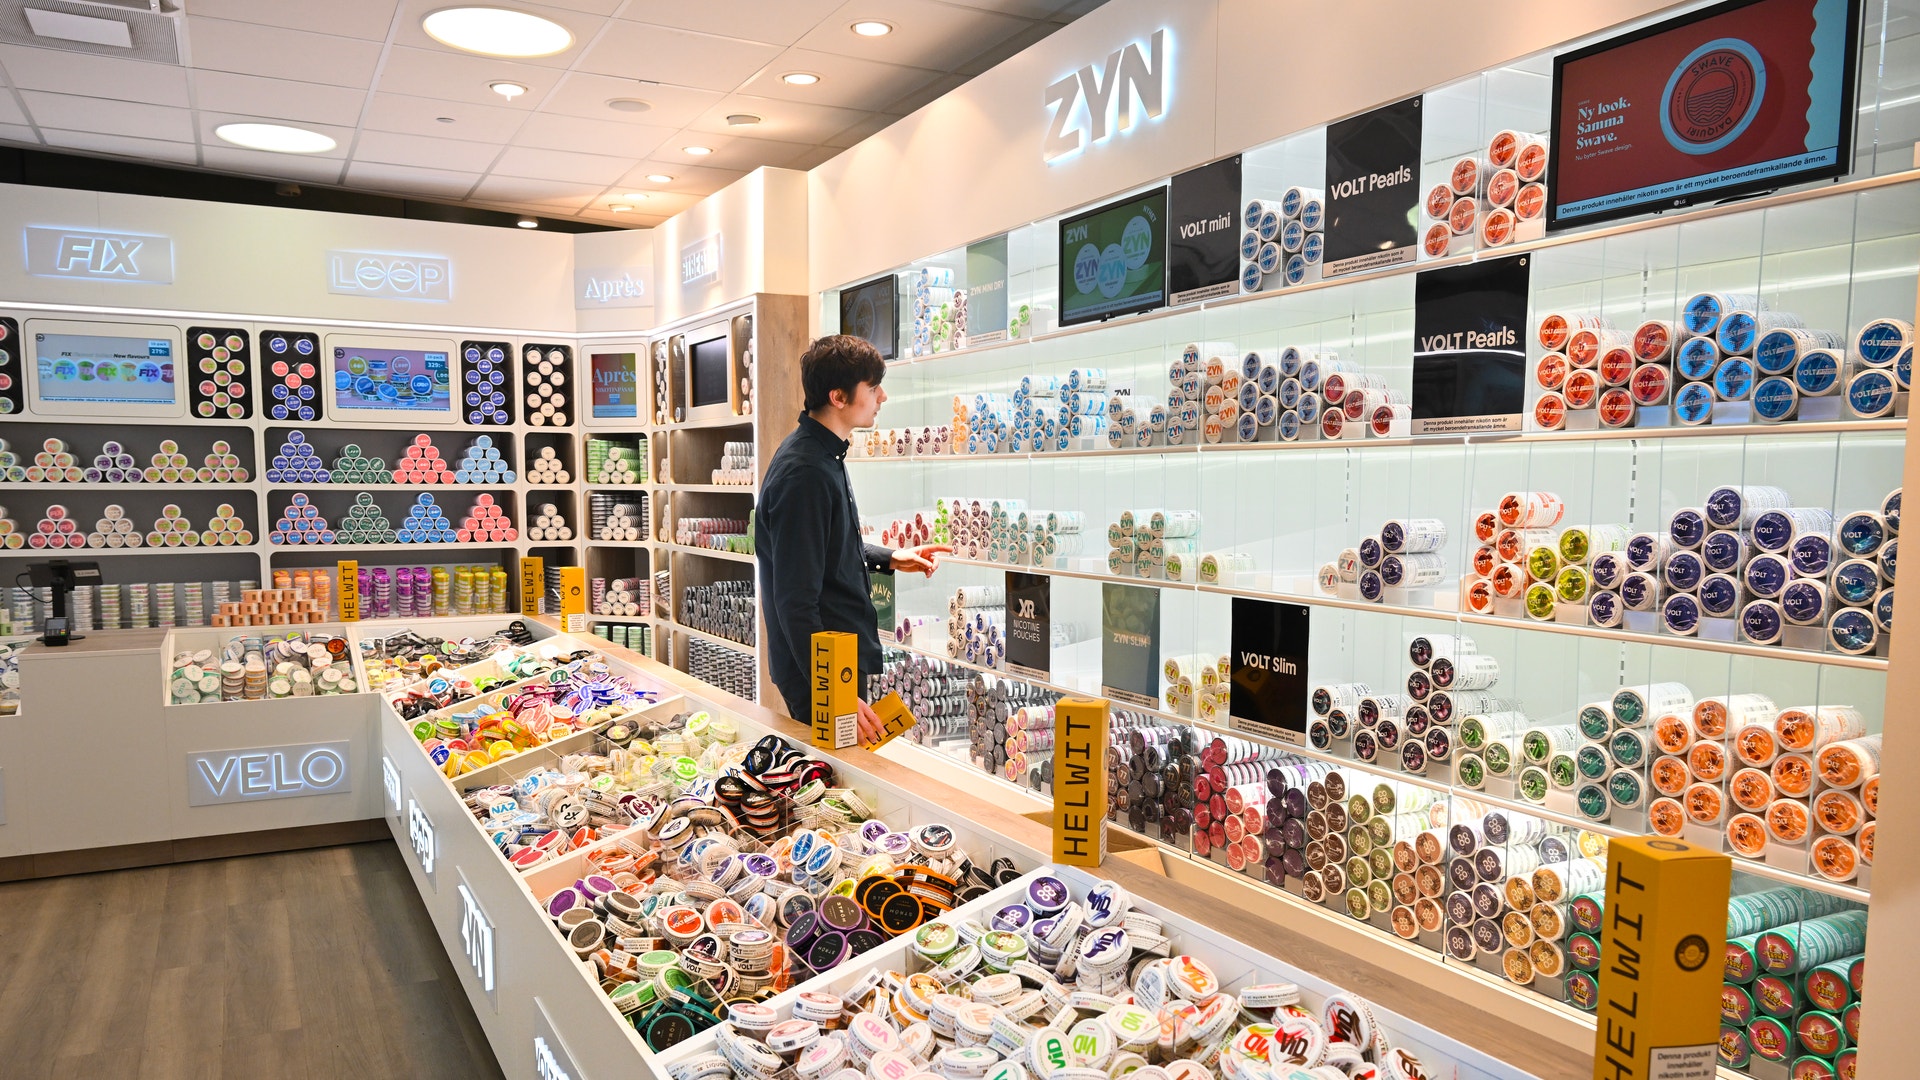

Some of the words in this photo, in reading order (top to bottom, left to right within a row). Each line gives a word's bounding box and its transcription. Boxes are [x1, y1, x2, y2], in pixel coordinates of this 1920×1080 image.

[1691, 56, 1735, 77] SWAVE
[1044, 28, 1165, 165] ZYN
[1578, 106, 1595, 121] Ny
[1597, 96, 1631, 117] look.
[1576, 113, 1624, 135] Samma
[1687, 117, 1733, 138] DAIQUIRI
[1576, 130, 1618, 150] Swave.
[1597, 147, 1613, 156] Swave
[1331, 174, 1367, 200] VOLT
[1562, 205, 1581, 215] Denna
[1581, 200, 1605, 213] produkt
[1605, 192, 1636, 208] innehåller
[1636, 190, 1659, 199] nikotin
[1660, 187, 1675, 195] som
[1675, 183, 1683, 192] är
[1684, 181, 1693, 190] ett
[1694, 176, 1720, 188] mycket
[1720, 159, 1803, 182] beroendeframkallande
[1803, 152, 1829, 166] ämne.
[1180, 218, 1207, 239] VOLT
[1208, 212, 1231, 231] mini
[1066, 224, 1088, 244] ZYN
[1123, 231, 1150, 252] ZYN
[57, 235, 143, 275] FIX
[333, 256, 444, 293] LOOP
[584, 272, 644, 302] Après
[1421, 332, 1463, 352] VOLT
[1184, 352, 1199, 362] ZYN
[1758, 349, 1777, 358] VOLT
[54, 366, 75, 376] FIX
[139, 368, 159, 378] FIX
[1170, 368, 1185, 378] ZYN
[1206, 365, 1223, 375] ZYN
[592, 366, 636, 386] Après
[1223, 377, 1239, 389] ZYN
[1206, 394, 1222, 404] ZYN
[1851, 390, 1872, 399] VOLT
[1109, 403, 1122, 413] ZYN
[1151, 413, 1164, 423] ZYN
[1168, 425, 1183, 436] ZYN
[1205, 424, 1221, 433] ZYN
[1109, 430, 1122, 440] ZYN
[1121, 519, 1133, 528] ZYN
[1674, 523, 1689, 531] VOLT
[1167, 561, 1181, 572] ZYN
[1202, 563, 1217, 573] ZYN
[1594, 567, 1608, 575] VOLT
[1751, 570, 1767, 578] VOLT
[1320, 575, 1339, 585] ZYN
[1839, 578, 1858, 586] VOLT
[344, 564, 355, 619] HELWIT
[524, 561, 534, 612] HELWIT
[1624, 586, 1637, 594] VOLT
[1702, 591, 1718, 599] VOLT
[1018, 598, 1036, 619] XR
[1013, 619, 1040, 633] NICOTINE
[1834, 626, 1854, 635] VOLT
[1013, 630, 1041, 643] POUCHES
[1113, 632, 1129, 645] ZYN
[1129, 635, 1148, 648] SLIM
[1241, 651, 1270, 670] VOLT
[1272, 656, 1297, 676] Slim
[816, 642, 829, 741] HELWIT
[197, 749, 343, 797] VELO
[1063, 715, 1090, 857] HELWIT
[1611, 783, 1625, 791] VOLT
[491, 802, 516, 814] ZYN
[837, 902, 847, 923] STRÖM
[671, 921, 684, 929] VOLT
[818, 946, 836, 954] STRÖM
[686, 963, 701, 973] VOLT
[732, 976, 740, 992] VOLT
[1657, 1052, 1681, 1061] Denna
[1682, 1050, 1712, 1062] produkt
[1666, 1060, 1704, 1070] innehåller
[1657, 1070, 1683, 1080] nikotin
